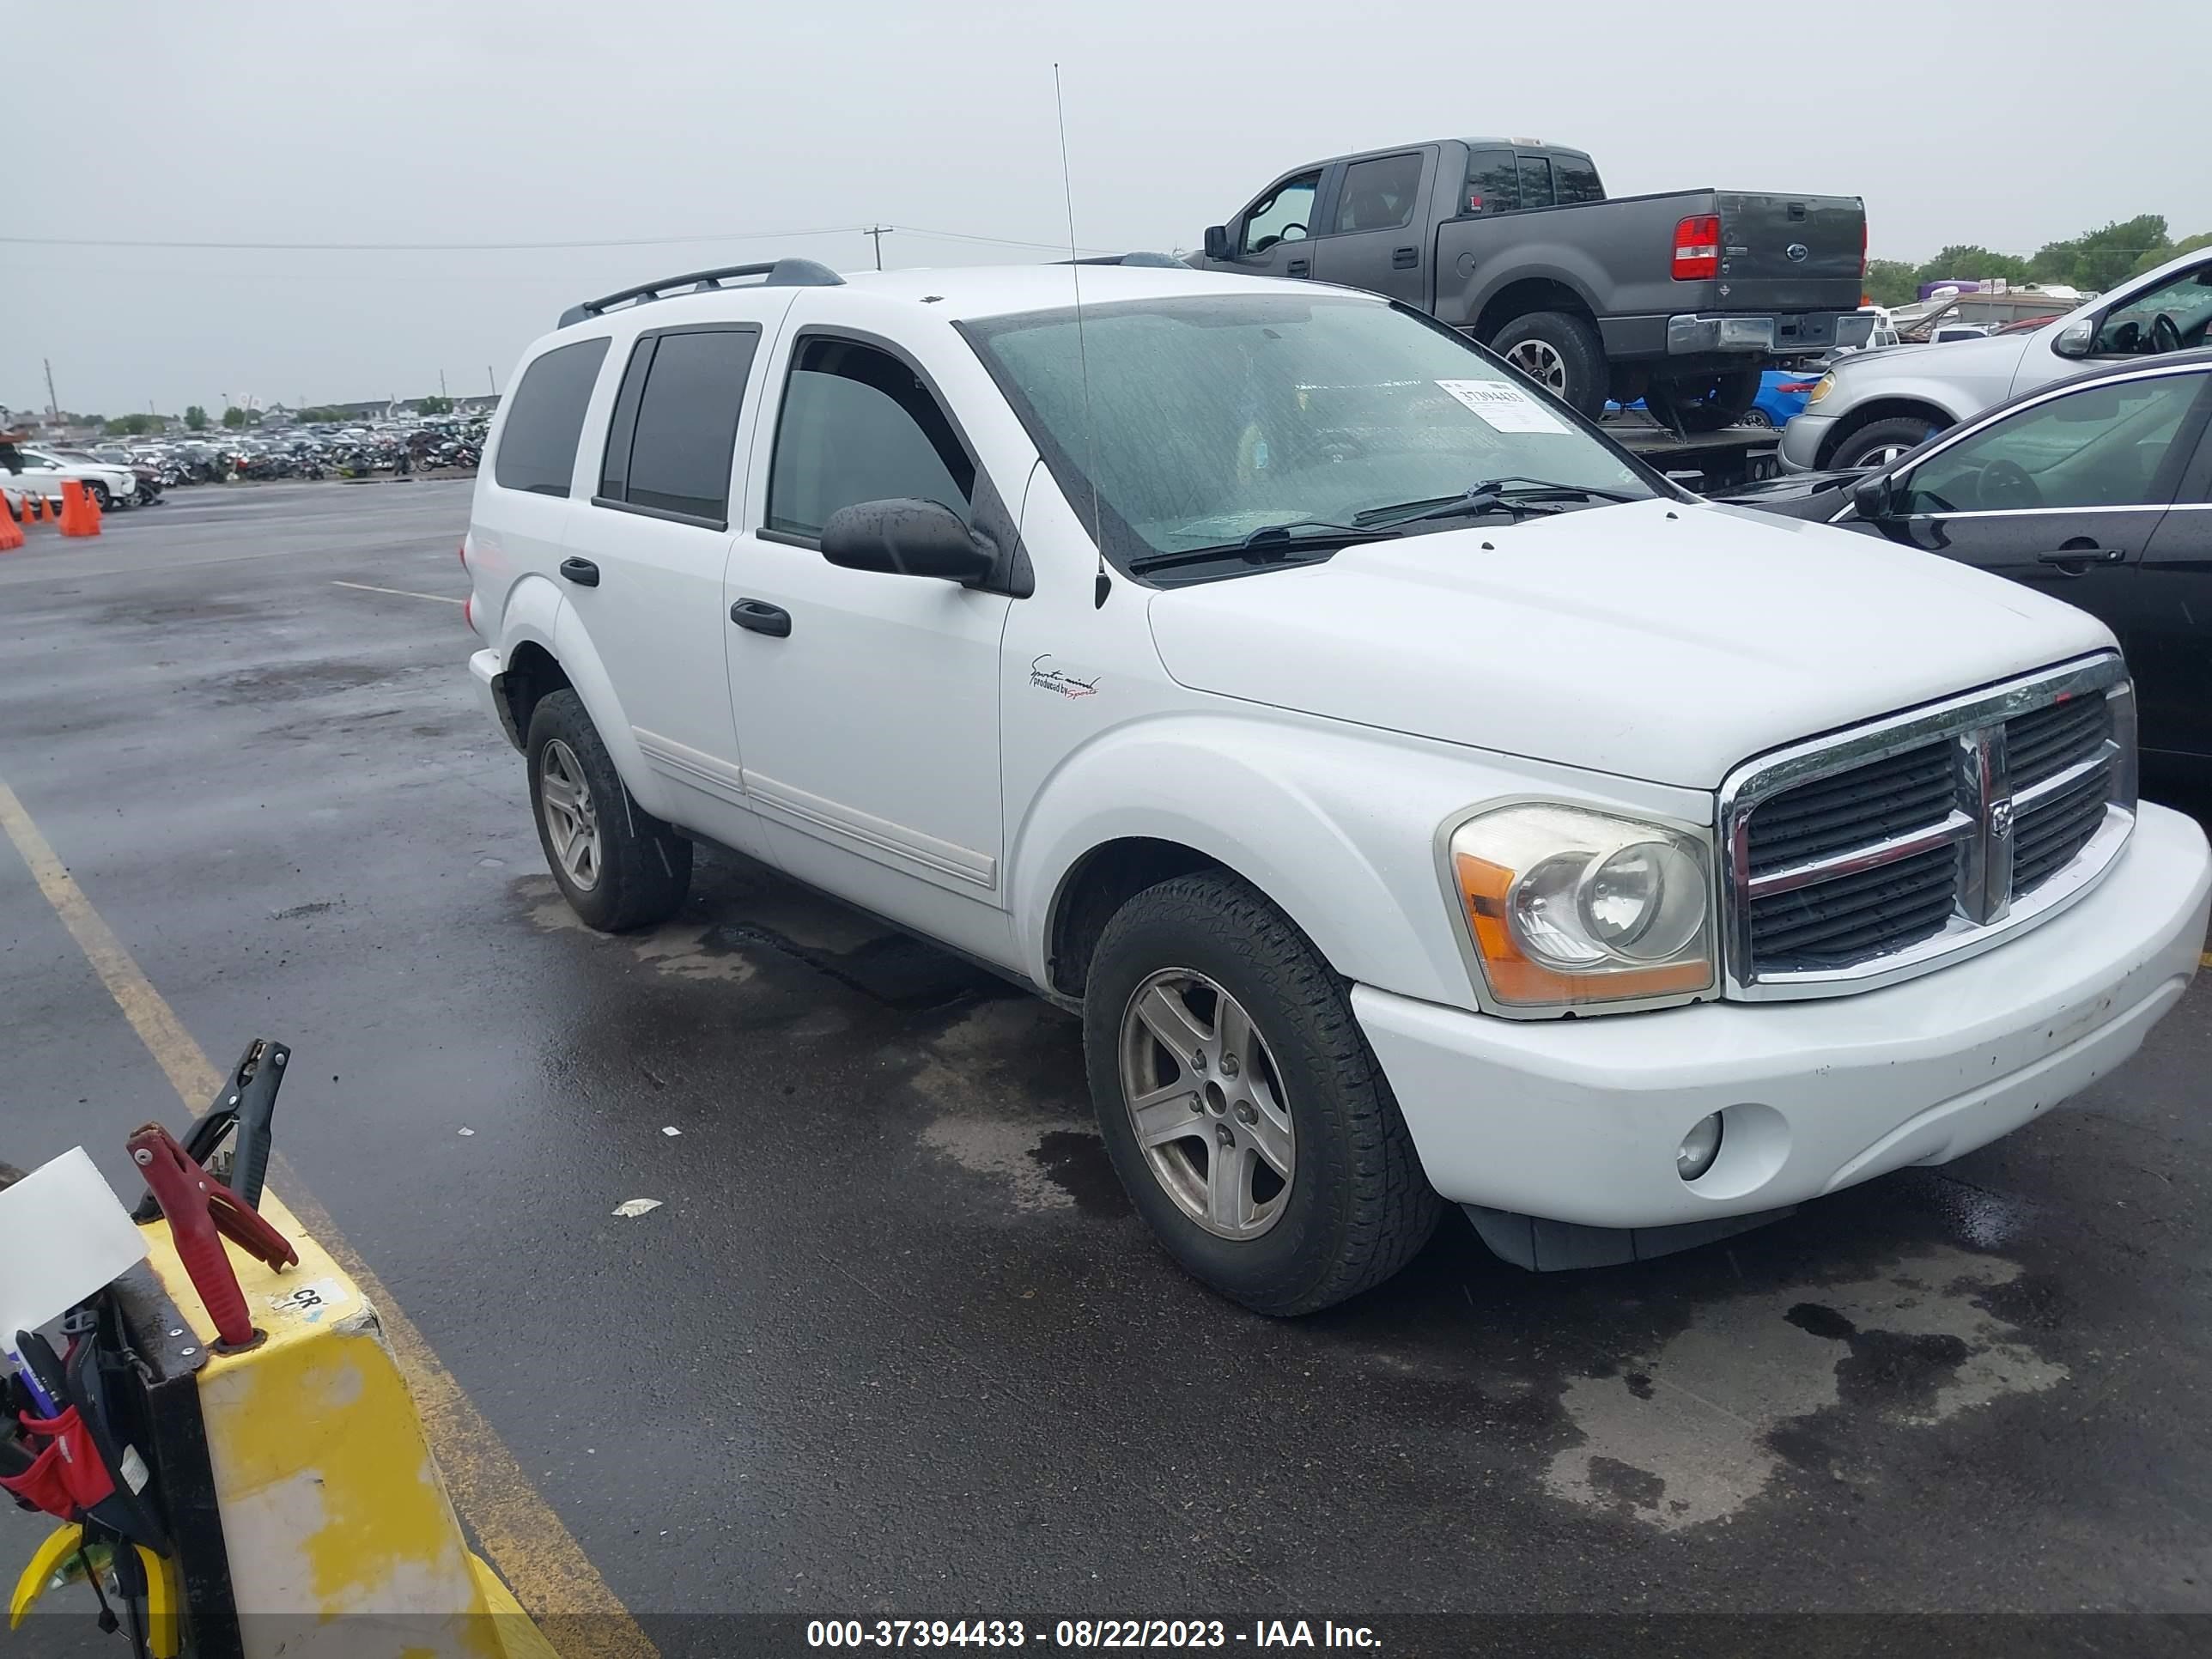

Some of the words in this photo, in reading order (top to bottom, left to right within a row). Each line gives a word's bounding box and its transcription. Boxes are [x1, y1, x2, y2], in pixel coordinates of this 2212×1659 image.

[1459, 391, 1524, 403] 37394433
[1033, 678, 1060, 693] produced
[1060, 684, 1068, 696] by
[1066, 688, 1099, 700] Sports
